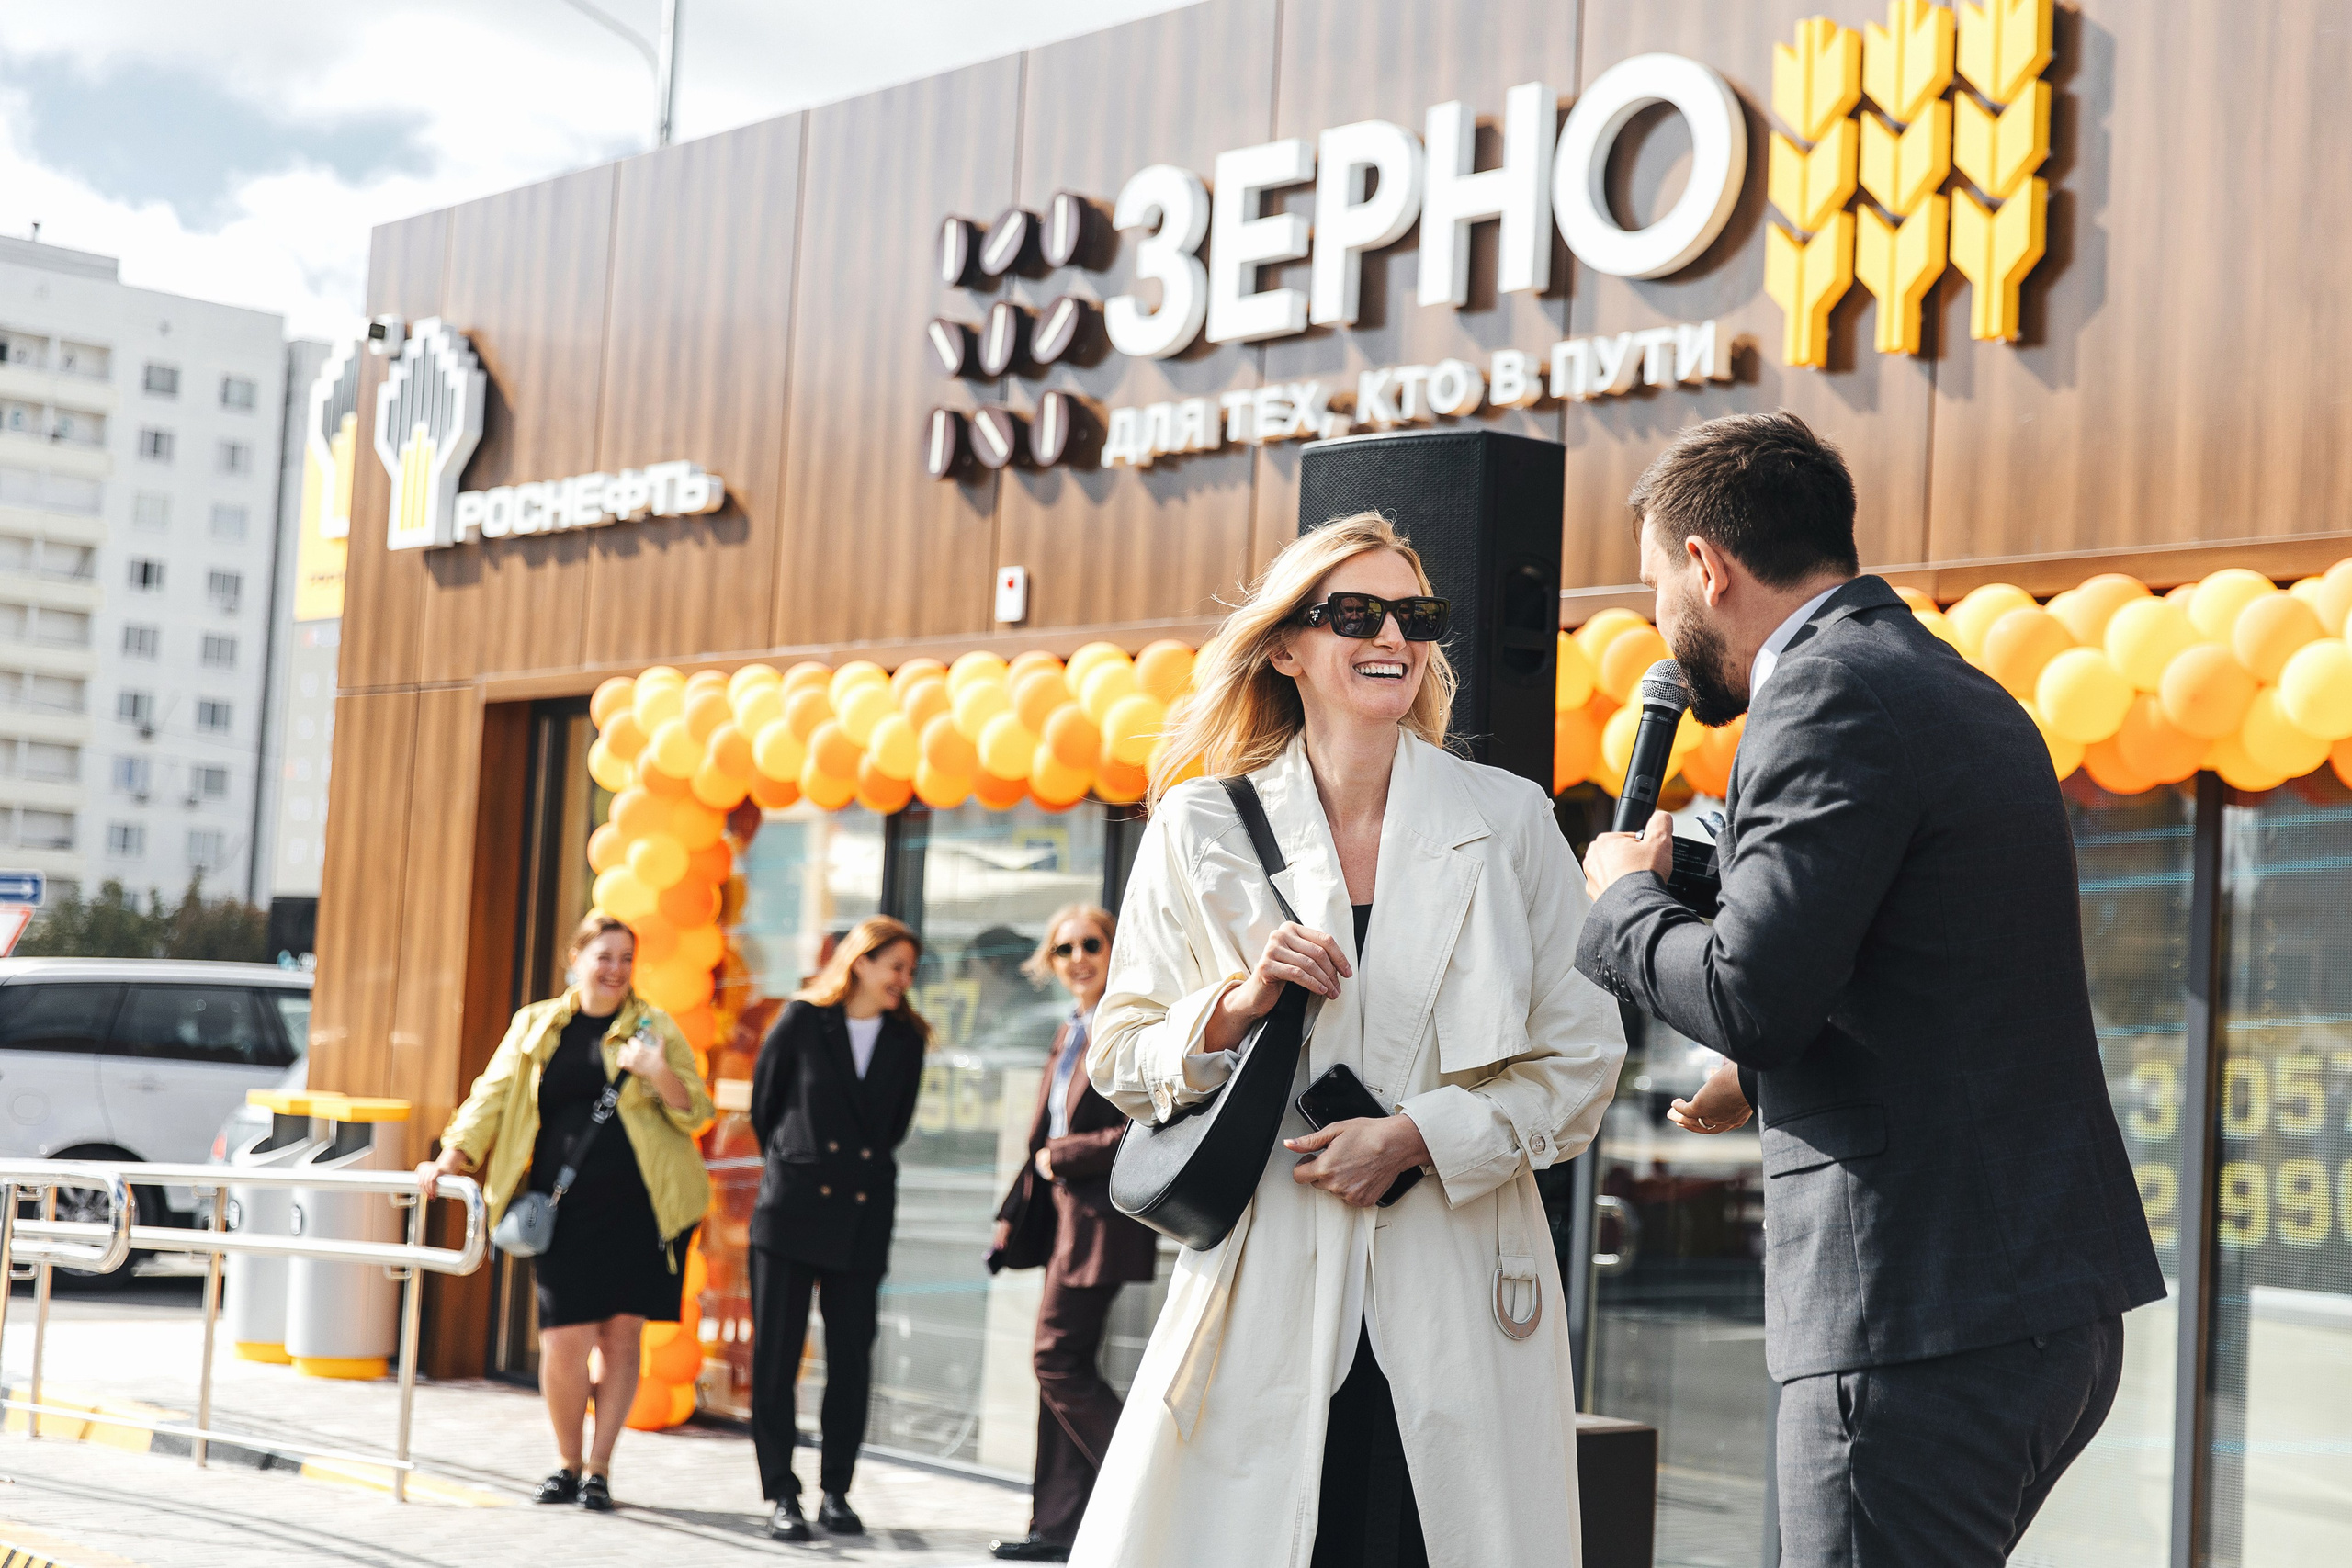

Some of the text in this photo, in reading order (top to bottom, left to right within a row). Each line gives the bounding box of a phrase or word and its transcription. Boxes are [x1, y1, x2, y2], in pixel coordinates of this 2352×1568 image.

[1104, 52, 1747, 359] ЗЕРНО
[1101, 320, 1728, 468] ДЛЯ ТЕХ, КТО В ПУТИ
[454, 460, 725, 542] РОСНЕФТЬ
